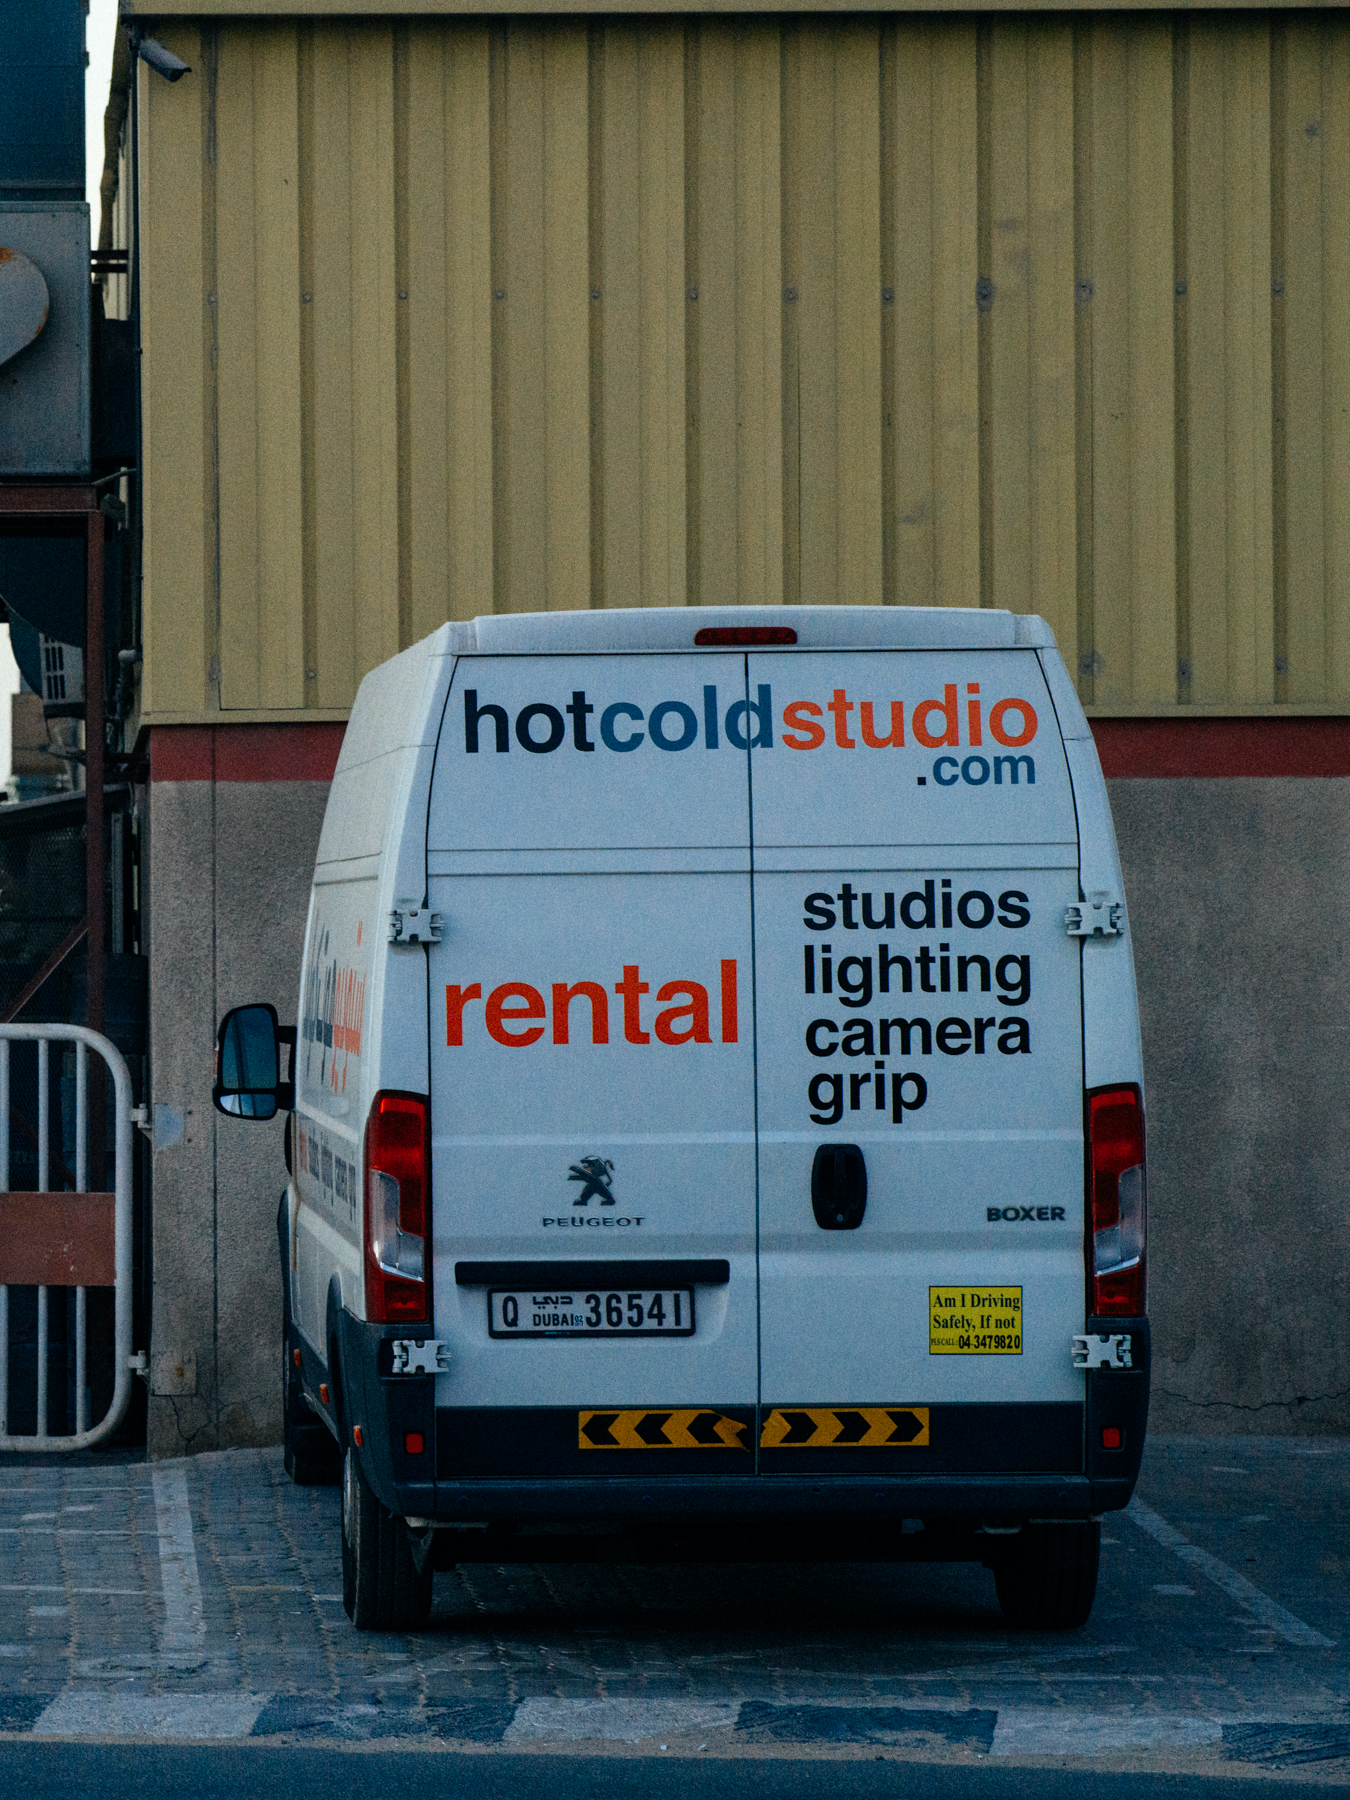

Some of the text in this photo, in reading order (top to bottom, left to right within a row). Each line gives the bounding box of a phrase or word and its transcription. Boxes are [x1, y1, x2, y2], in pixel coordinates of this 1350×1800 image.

[464, 683, 1038, 753] hotcoldstudio
[916, 754, 1037, 786] .com
[804, 879, 1031, 931] studios
[805, 943, 1032, 1007] lighting
[445, 959, 739, 1047] rental
[806, 1017, 1032, 1057] camera
[808, 1060, 928, 1125] grip
[542, 1216, 645, 1227] PEUGEOT
[986, 1205, 1066, 1222] BOXER
[502, 1295, 519, 1328] Q
[585, 1293, 682, 1328] 36541
[933, 1293, 1020, 1311] Am I Driving
[533, 1313, 574, 1326] DUBAI
[933, 1314, 1016, 1333] Safely, If not
